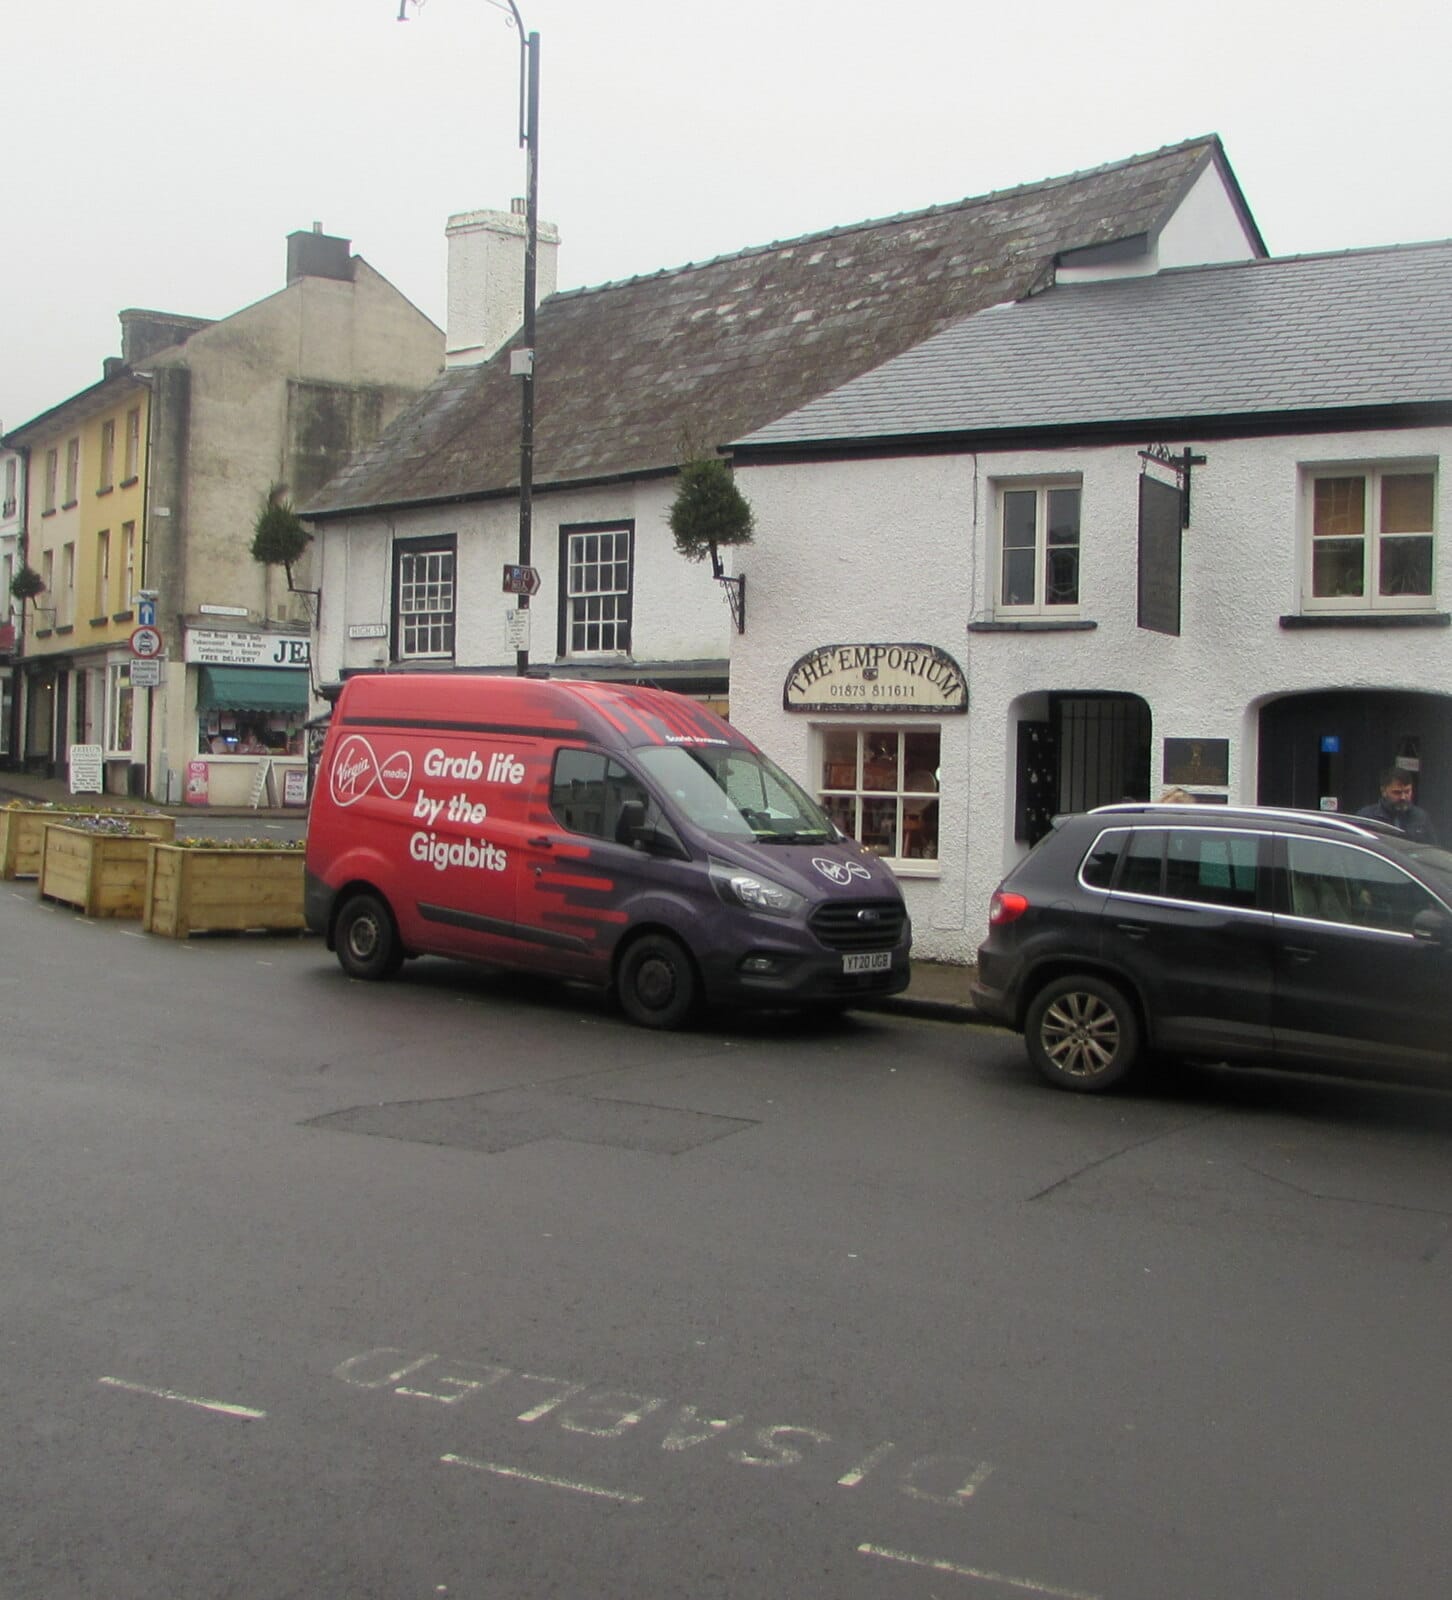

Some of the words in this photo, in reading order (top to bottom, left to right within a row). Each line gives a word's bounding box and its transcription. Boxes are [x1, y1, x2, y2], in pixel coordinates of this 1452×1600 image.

[222, 655, 256, 663] DELIVERY
[789, 654, 832, 693] THE
[838, 646, 962, 699] EMPORIUM
[830, 684, 866, 697] 01873
[871, 684, 916, 698] 811611
[336, 747, 370, 795] Virgin
[382, 768, 408, 779] media
[424, 748, 483, 780] Grab
[488, 752, 525, 784] life
[413, 788, 446, 826] by
[447, 794, 486, 824] the
[409, 831, 508, 872] Gigabits
[847, 955, 870, 969] YT20
[332, 1345, 998, 1508] DISABLED
